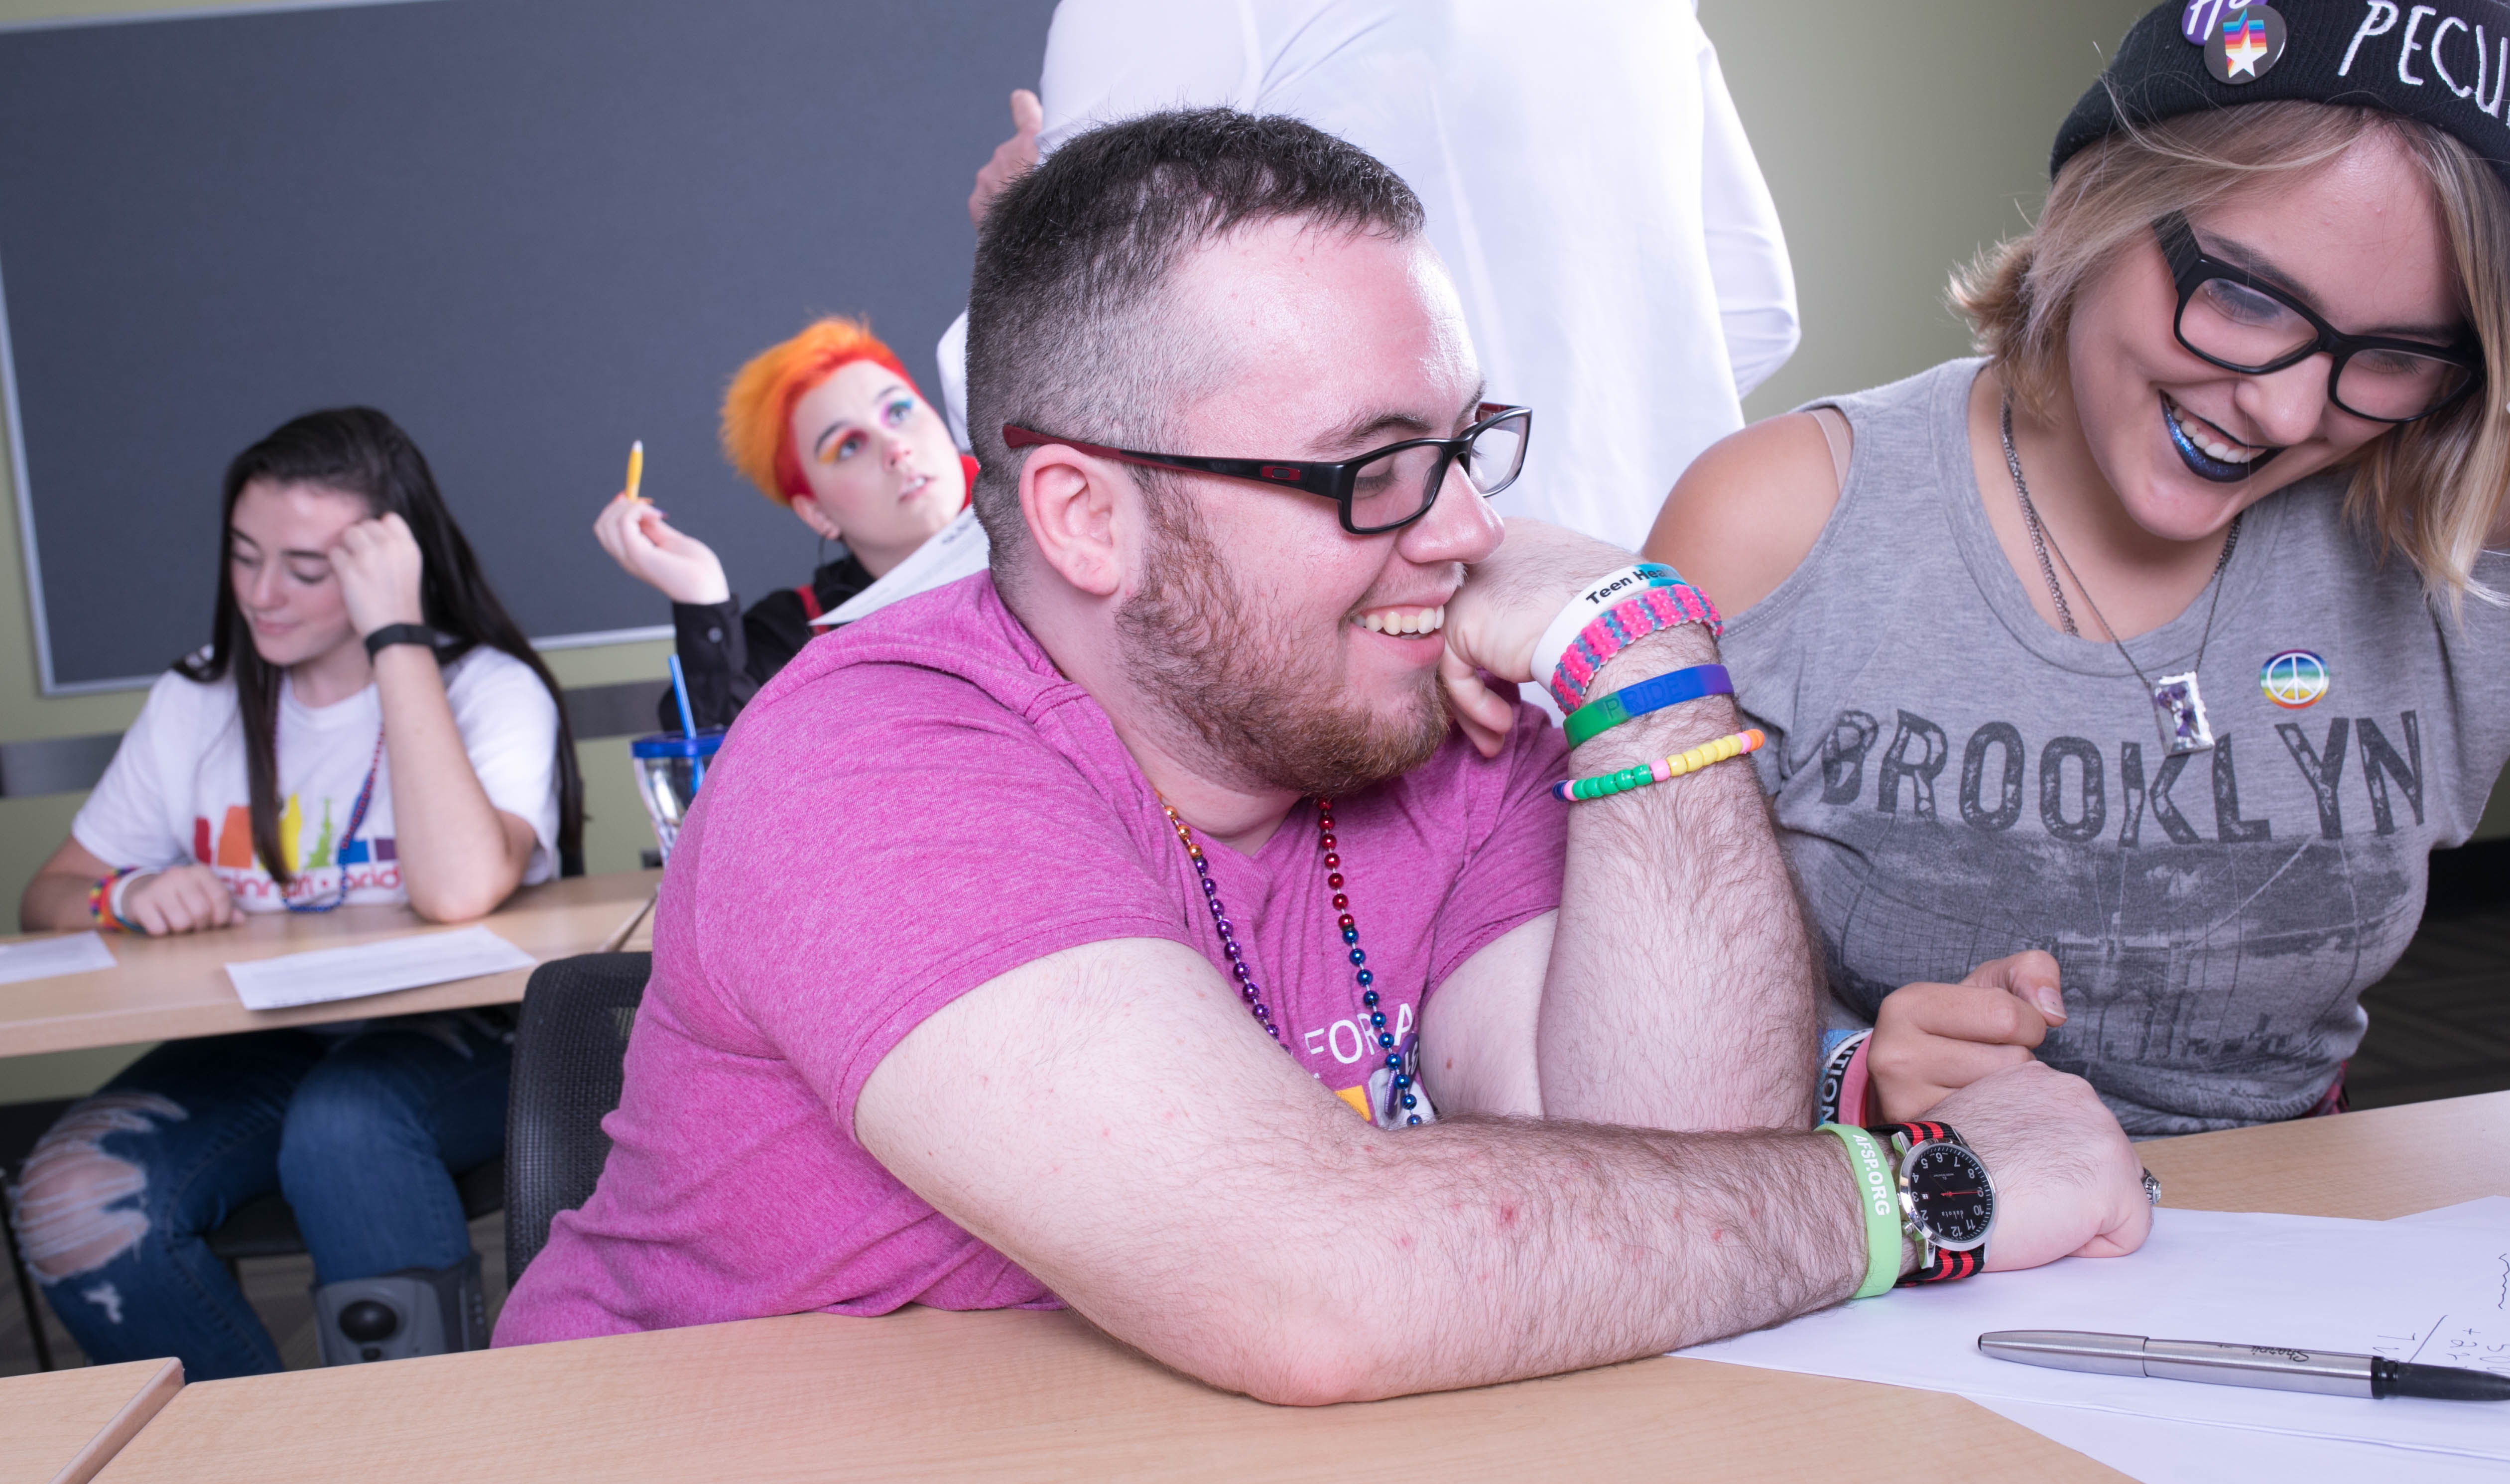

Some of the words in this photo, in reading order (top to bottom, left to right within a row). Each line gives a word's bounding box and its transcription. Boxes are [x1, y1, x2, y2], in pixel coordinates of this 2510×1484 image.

[2338, 0, 2510, 128] PECU
[1586, 577, 1632, 604] Teen
[1604, 675, 1683, 720] PRIDE
[1821, 709, 2424, 847] BROOKLYN
[1936, 1152, 1943, 1163] 6
[1954, 1156, 1960, 1167] 7
[1921, 1158, 1928, 1169] 5
[1852, 1134, 1890, 1216] AFSP.ORG
[1912, 1173, 1919, 1183] 4
[1968, 1168, 1975, 1179] 8
[1912, 1192, 1919, 1202] 3
[1921, 1210, 1928, 1221] 2
[1973, 1205, 1984, 1216] 10
[1937, 1223, 1943, 1233] 1
[1966, 1219, 1976, 1231] 11
[1950, 1226, 1963, 1237] 12
